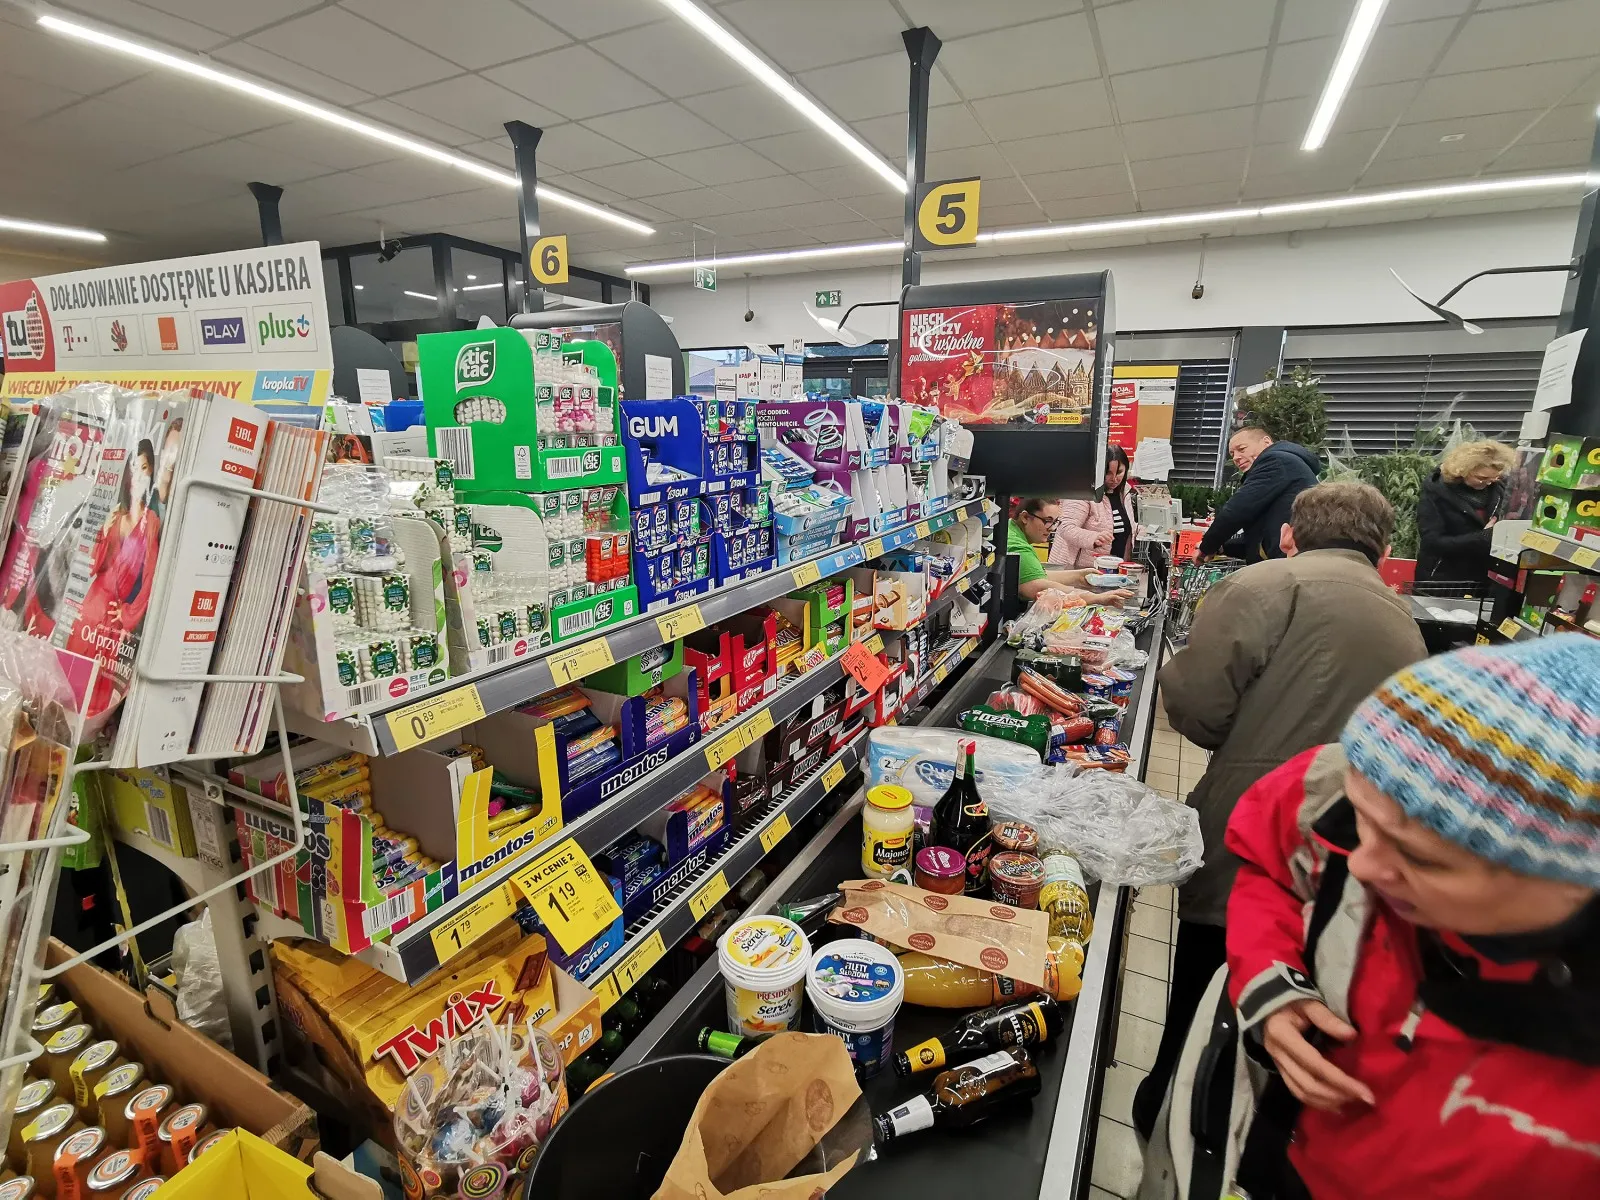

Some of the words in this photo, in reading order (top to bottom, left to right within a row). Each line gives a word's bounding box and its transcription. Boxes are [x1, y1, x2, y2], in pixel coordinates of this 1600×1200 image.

[935, 193, 966, 234] 5
[541, 245, 560, 276] 6
[50, 276, 139, 312] DOŁADOWANIE
[139, 266, 216, 308] DOSTĘPNE
[220, 265, 231, 297] U
[234, 256, 311, 295] KASJERA
[6, 314, 27, 346] tu
[204, 323, 240, 339] PLAY
[258, 312, 296, 346] plus
[909, 313, 944, 327] NIECH
[909, 322, 961, 339] POŁĄCZY
[909, 335, 932, 348] NAS
[934, 331, 985, 354] wspólne
[468, 347, 489, 364] tic
[463, 363, 489, 378] tac
[8, 379, 44, 398] WIĘCEJ
[44, 376, 66, 395] NIŻ
[235, 426, 253, 443] JBL
[629, 415, 679, 438] GUM
[224, 461, 238, 472] GO
[1184, 543, 1190, 555] 8
[197, 597, 214, 611] JBL
[665, 622, 676, 639] 2
[81, 624, 96, 644] Od
[96, 630, 136, 660] przyjaźni
[94, 652, 107, 668] do
[107, 658, 133, 681] miłości
[561, 662, 571, 681] 1
[569, 658, 578, 668] 79
[854, 665, 868, 682] 2
[410, 716, 426, 739] 0
[422, 710, 434, 722] 89
[714, 751, 721, 765] 3
[884, 759, 891, 769] 2
[601, 747, 668, 799] mentos
[688, 801, 723, 843] mentos
[767, 833, 773, 846] 1
[460, 828, 535, 883] mentos
[875, 847, 909, 860] Majonez
[524, 878, 532, 889] 3
[531, 871, 543, 883] W
[543, 858, 567, 877] CENIE
[566, 853, 575, 862] 2
[653, 849, 707, 903] mentos
[558, 881, 576, 900] 19
[548, 892, 570, 923] 1
[700, 898, 707, 913] 1
[450, 928, 462, 949] 1
[460, 919, 471, 932] 79
[741, 928, 767, 953] Serek
[578, 941, 610, 975] OREO
[626, 967, 634, 983] 1
[757, 998, 793, 1016] Serek
